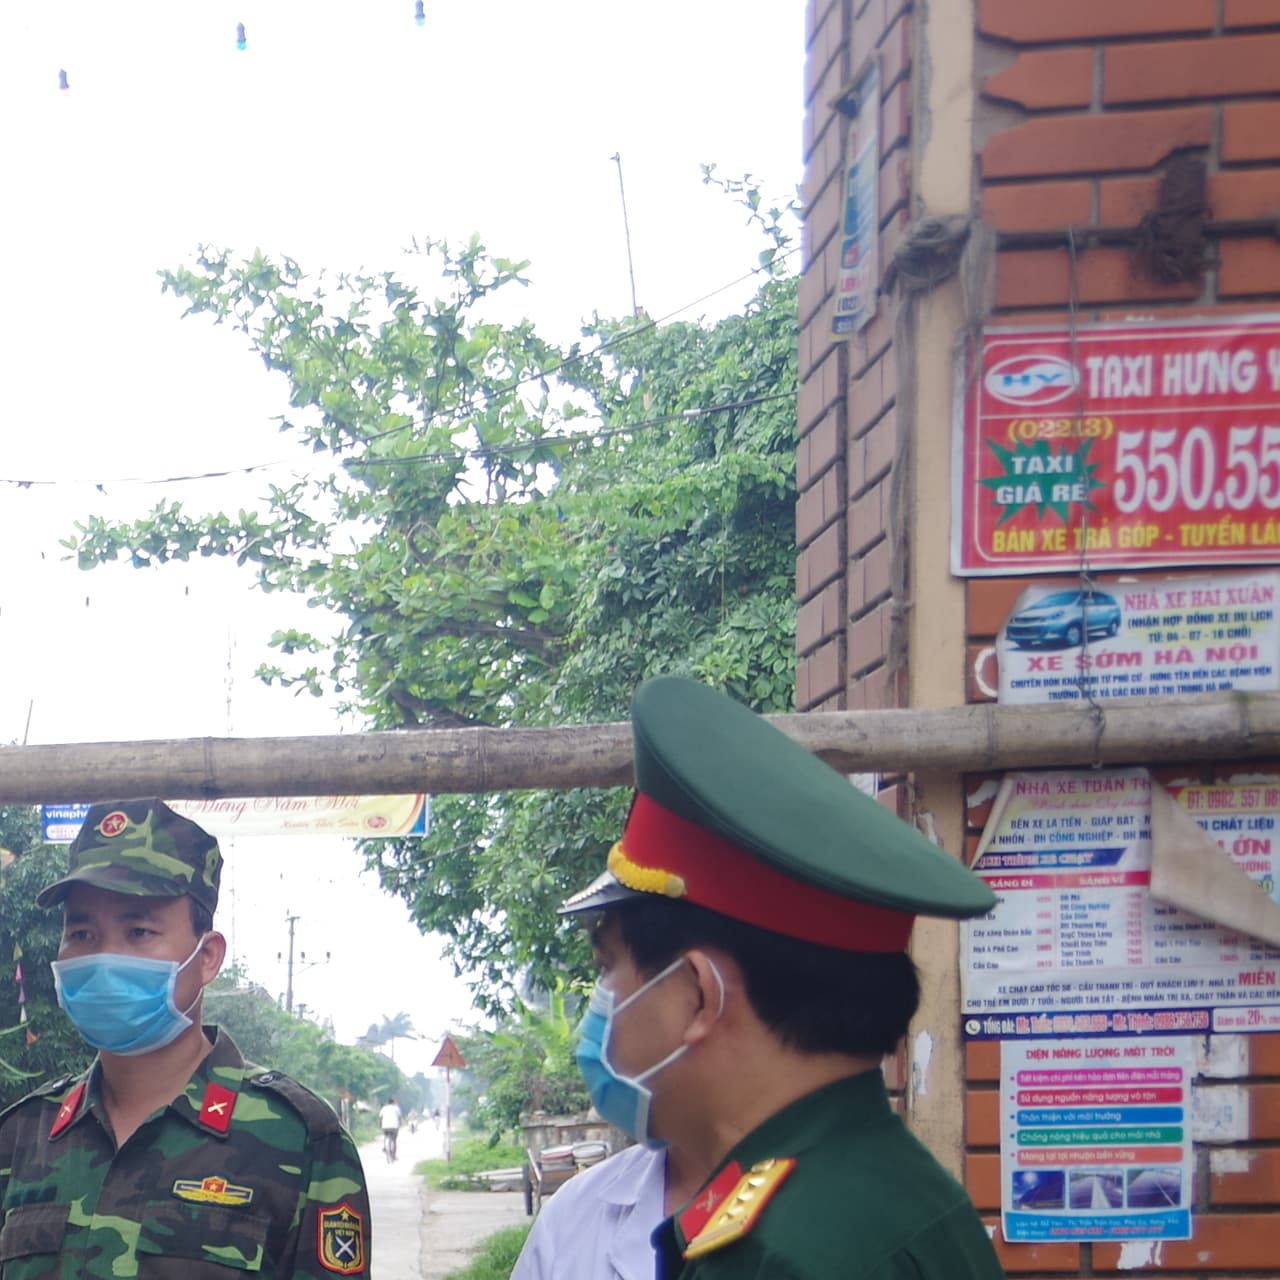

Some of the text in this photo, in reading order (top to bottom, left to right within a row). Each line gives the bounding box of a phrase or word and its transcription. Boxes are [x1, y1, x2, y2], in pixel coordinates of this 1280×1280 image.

[1002, 373, 1064, 387] HY
[1087, 355, 1152, 399] TAXI
[1162, 349, 1258, 396] HƯNG
[1011, 455, 1073, 475] TAXI
[996, 481, 1043, 505] GIÁ
[993, 526, 1035, 552] BÁN
[1042, 528, 1067, 551] XE
[1074, 516, 1111, 550] TRẢ
[1118, 520, 1159, 548] GÓP
[1165, 591, 1186, 609] XE
[1226, 582, 1274, 605] XUÂN
[1027, 642, 1258, 672] XE SỚM HÀ NỘI
[1057, 780, 1078, 794] XE
